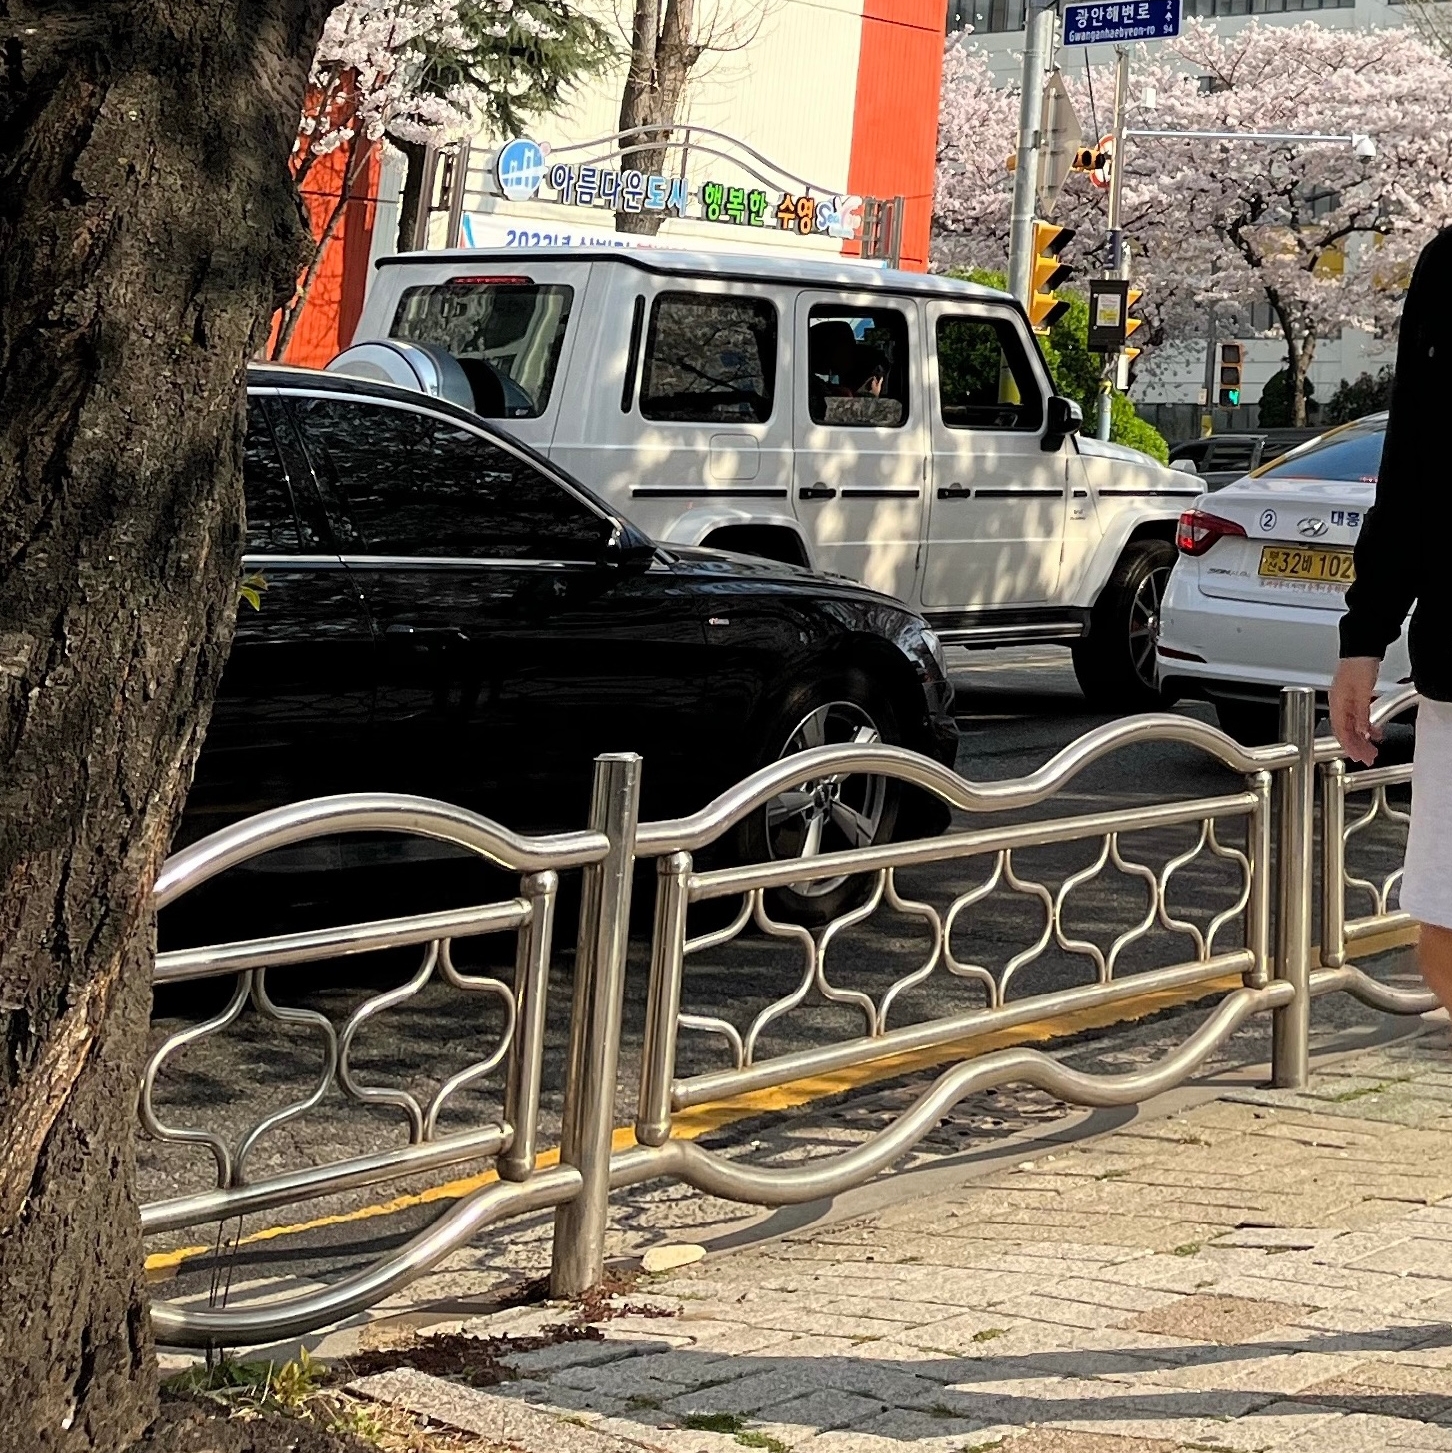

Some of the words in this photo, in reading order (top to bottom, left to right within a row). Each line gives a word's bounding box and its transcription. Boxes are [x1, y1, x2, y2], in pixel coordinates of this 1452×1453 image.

[1167, 0, 1172, 9] 2
[1075, 3, 1150, 28] 광안해변로
[1069, 26, 1156, 42] Gwanganhaebyeon-ro
[1163, 24, 1173, 34] 94
[704, 181, 767, 227] 행복한
[777, 194, 814, 235] 수영
[1278, 551, 1313, 574] 32바
[1320, 555, 1357, 579] 102
